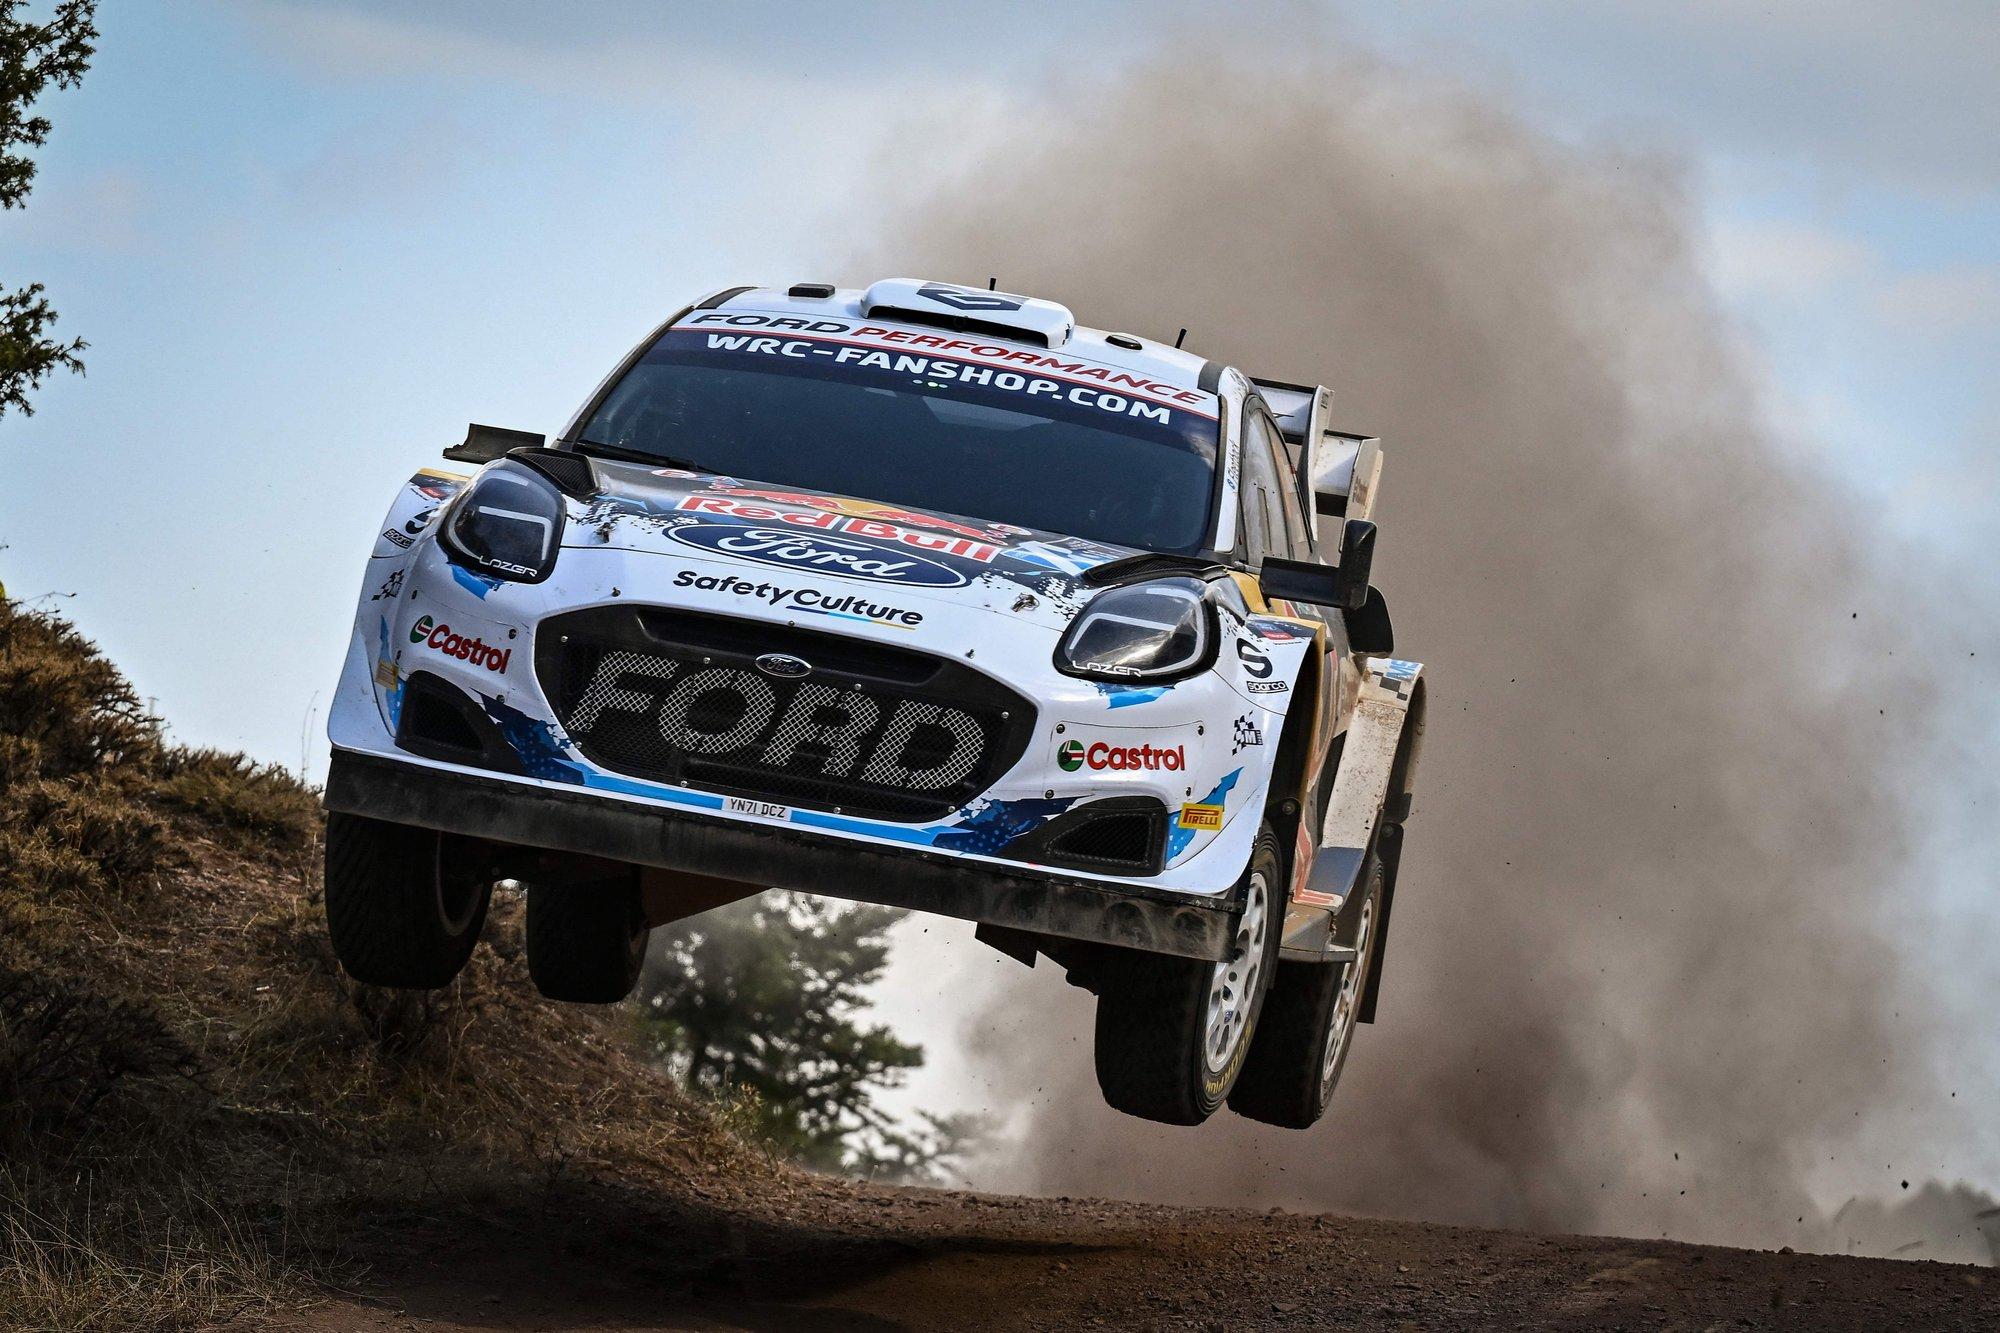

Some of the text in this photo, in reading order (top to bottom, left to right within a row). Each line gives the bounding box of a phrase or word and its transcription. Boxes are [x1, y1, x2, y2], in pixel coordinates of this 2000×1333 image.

[690, 314, 1208, 405] FORD PERFORMANCE
[707, 334, 1171, 425] WRC-FANSHOP.COM
[676, 496, 999, 563] Red Bull
[717, 529, 917, 577] Ford
[672, 570, 923, 626] SafetyCulture
[427, 624, 512, 675] Castrol
[1247, 681, 1287, 692] sparco
[565, 649, 986, 791] FORD
[1086, 741, 1186, 772] Castrol
[730, 798, 787, 819] YN71 DCZ
[1182, 807, 1220, 826] PIRELLI
